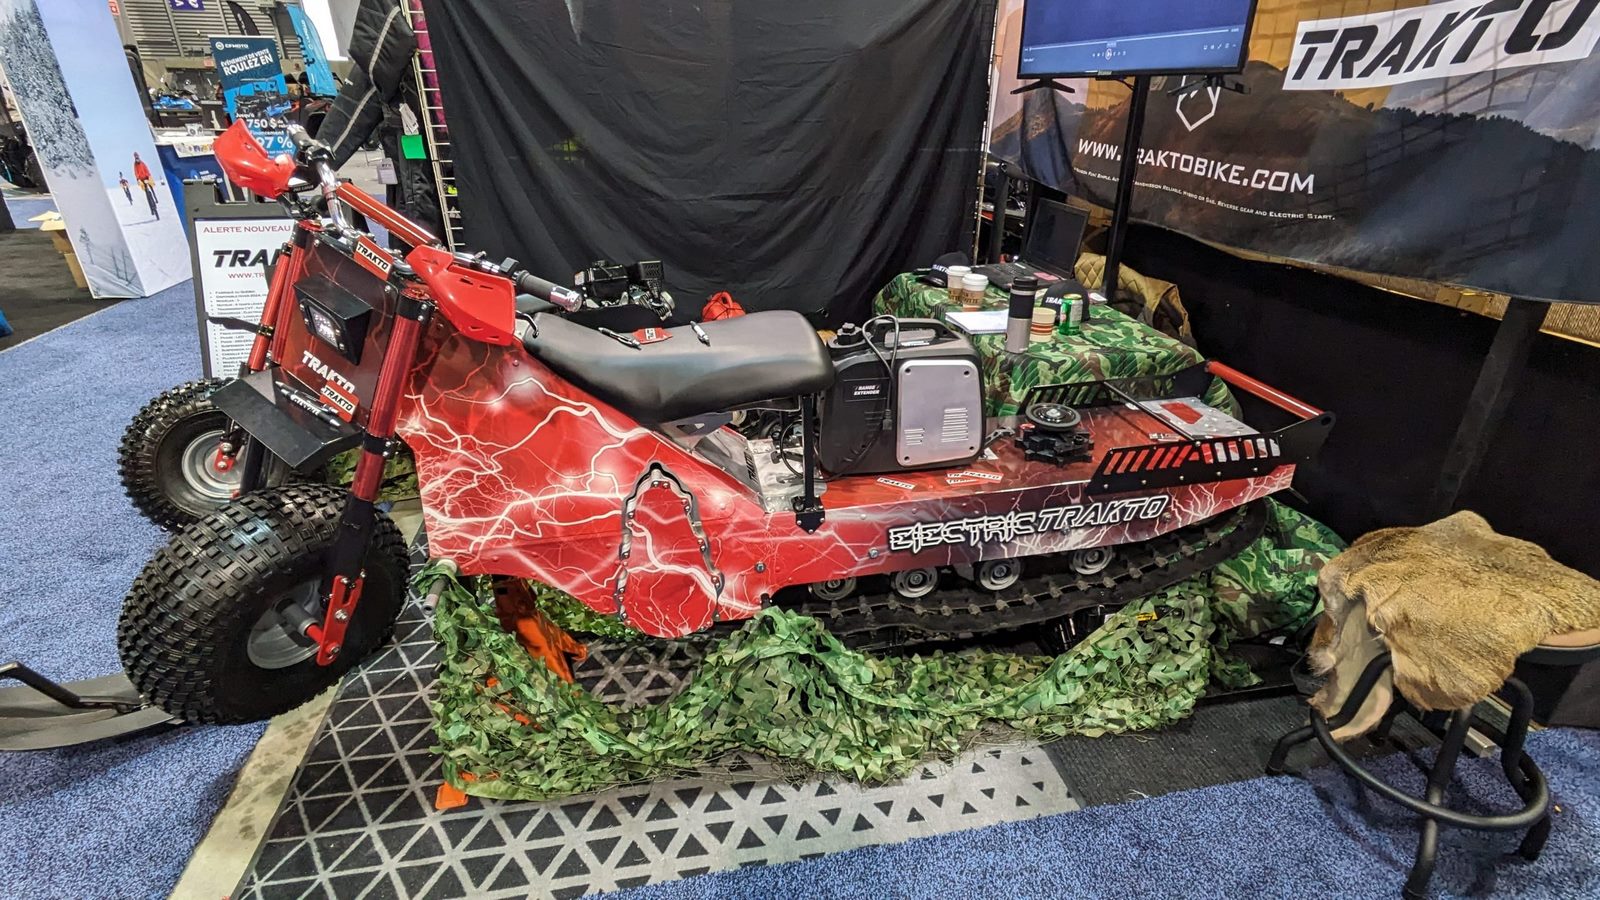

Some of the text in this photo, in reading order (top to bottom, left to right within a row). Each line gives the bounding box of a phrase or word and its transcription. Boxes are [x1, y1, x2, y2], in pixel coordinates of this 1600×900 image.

[1291, 0, 1600, 81] TRAKTO
[223, 53, 274, 76] ROULEZ EN
[246, 118, 268, 128] 750
[1078, 138, 1315, 195] WWW.RAKTOBIKE.COM
[1269, 211, 1304, 219] ELECTRIC
[203, 225, 291, 234] ALERTE NOUVEAU
[356, 243, 390, 270] TRAKTO
[302, 350, 355, 395] TRAKTO
[323, 386, 354, 412] TRAKTO
[888, 495, 1170, 553] ELECTRIC TRAKTO
